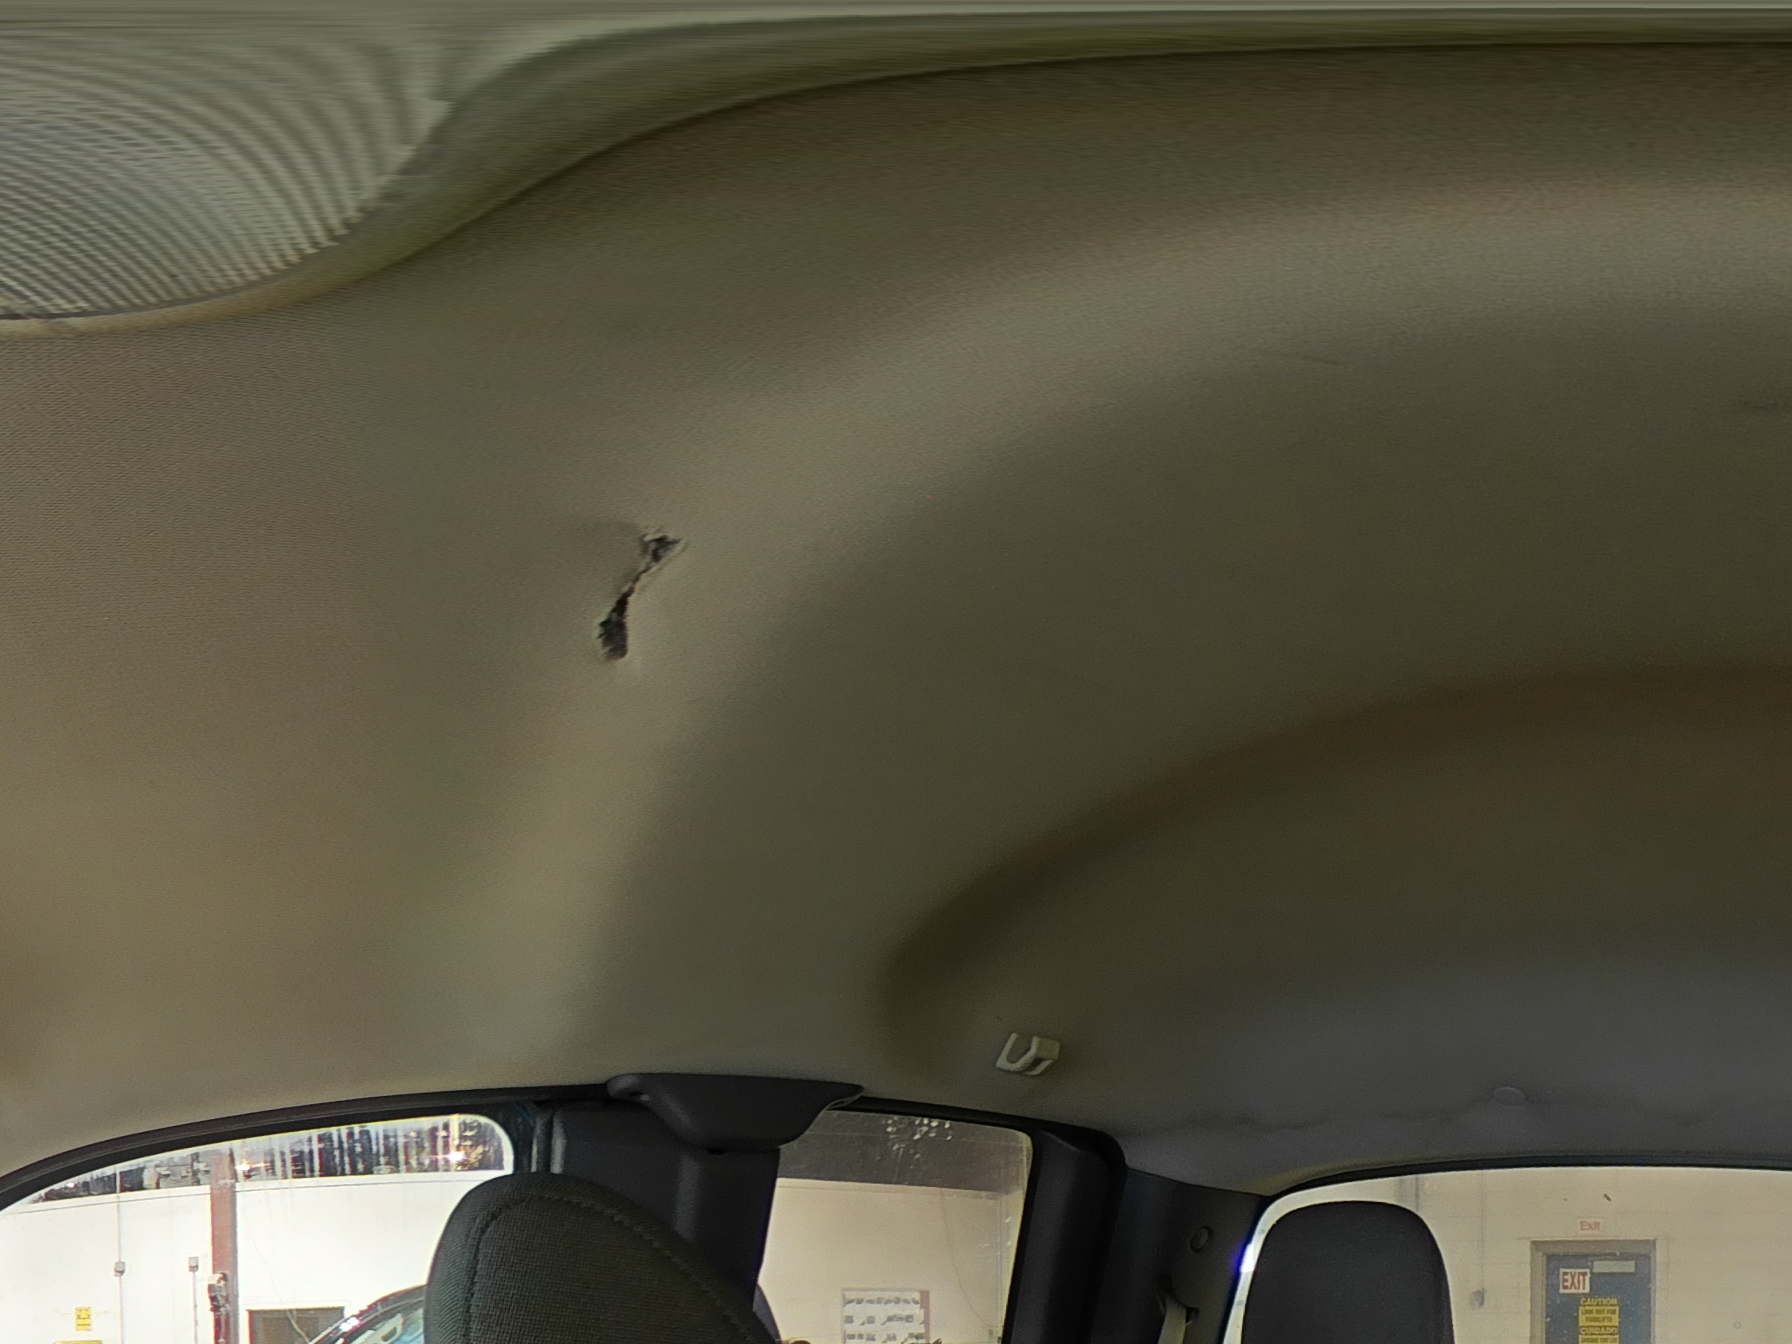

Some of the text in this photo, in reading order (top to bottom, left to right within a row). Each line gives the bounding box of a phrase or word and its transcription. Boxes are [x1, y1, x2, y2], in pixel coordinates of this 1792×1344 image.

[1580, 1221, 1601, 1231] Exit
[1561, 1271, 1588, 1290] EXIT
[1580, 1297, 1619, 1306] CAUTION
[1579, 1327, 1618, 1335] CUIDADO
